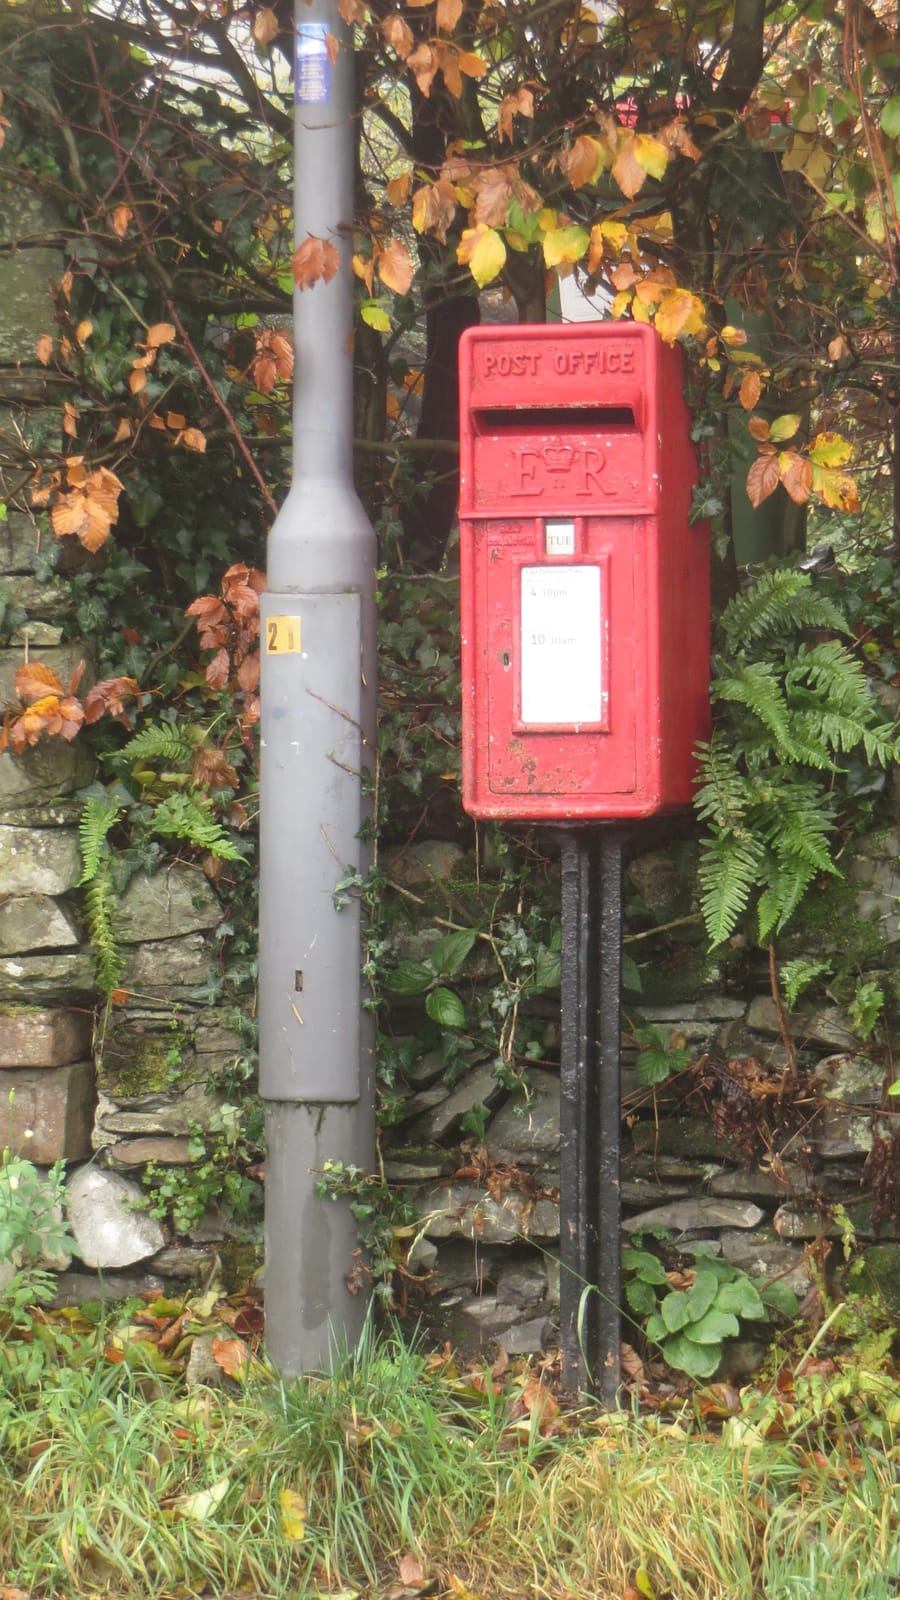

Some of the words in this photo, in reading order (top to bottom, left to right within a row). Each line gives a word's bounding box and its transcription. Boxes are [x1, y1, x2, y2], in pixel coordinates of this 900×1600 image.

[483, 352, 541, 377] POST
[554, 350, 635, 375] OFFICE
[548, 535, 573, 546] TUE
